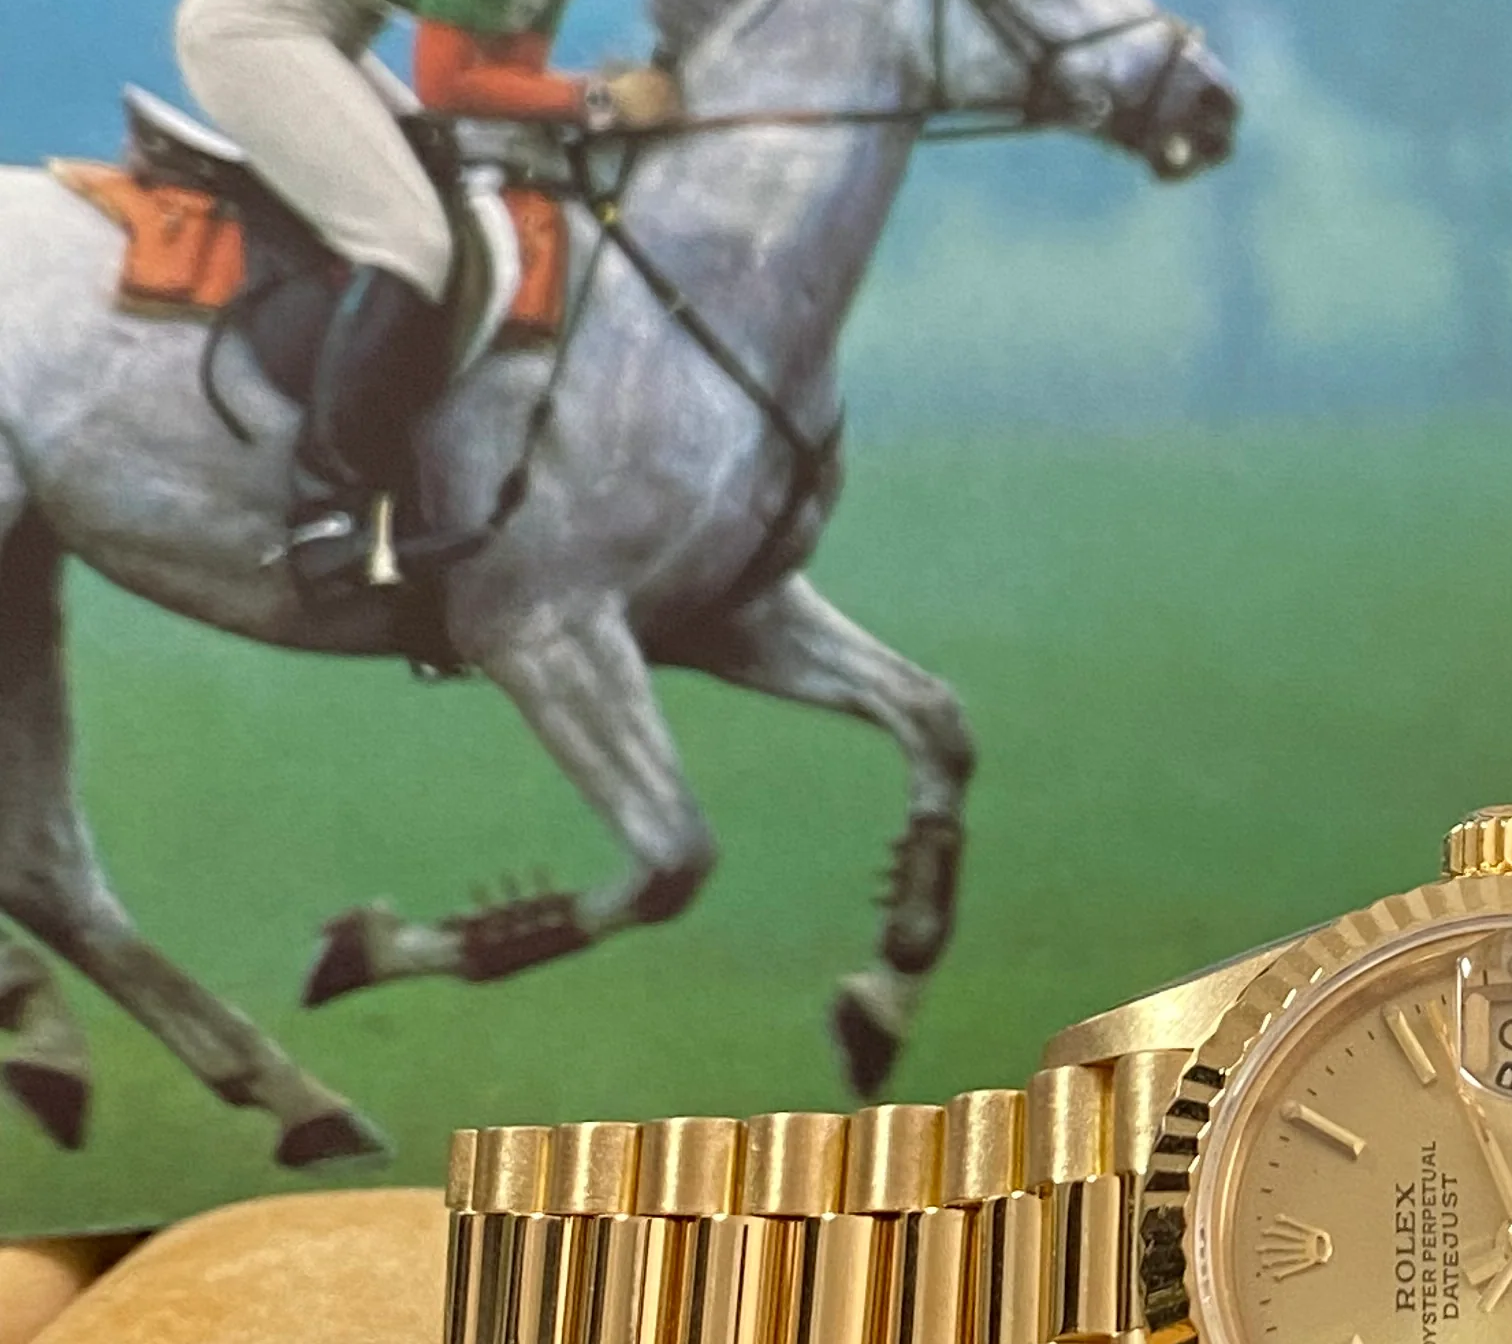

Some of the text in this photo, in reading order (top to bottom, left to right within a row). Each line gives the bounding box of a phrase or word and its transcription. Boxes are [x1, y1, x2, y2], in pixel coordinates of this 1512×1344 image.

[1395, 1181, 1416, 1313] ROLEX
[1421, 1140, 1437, 1263] PERPETUAL
[1441, 1172, 1460, 1320] DATEJUST
